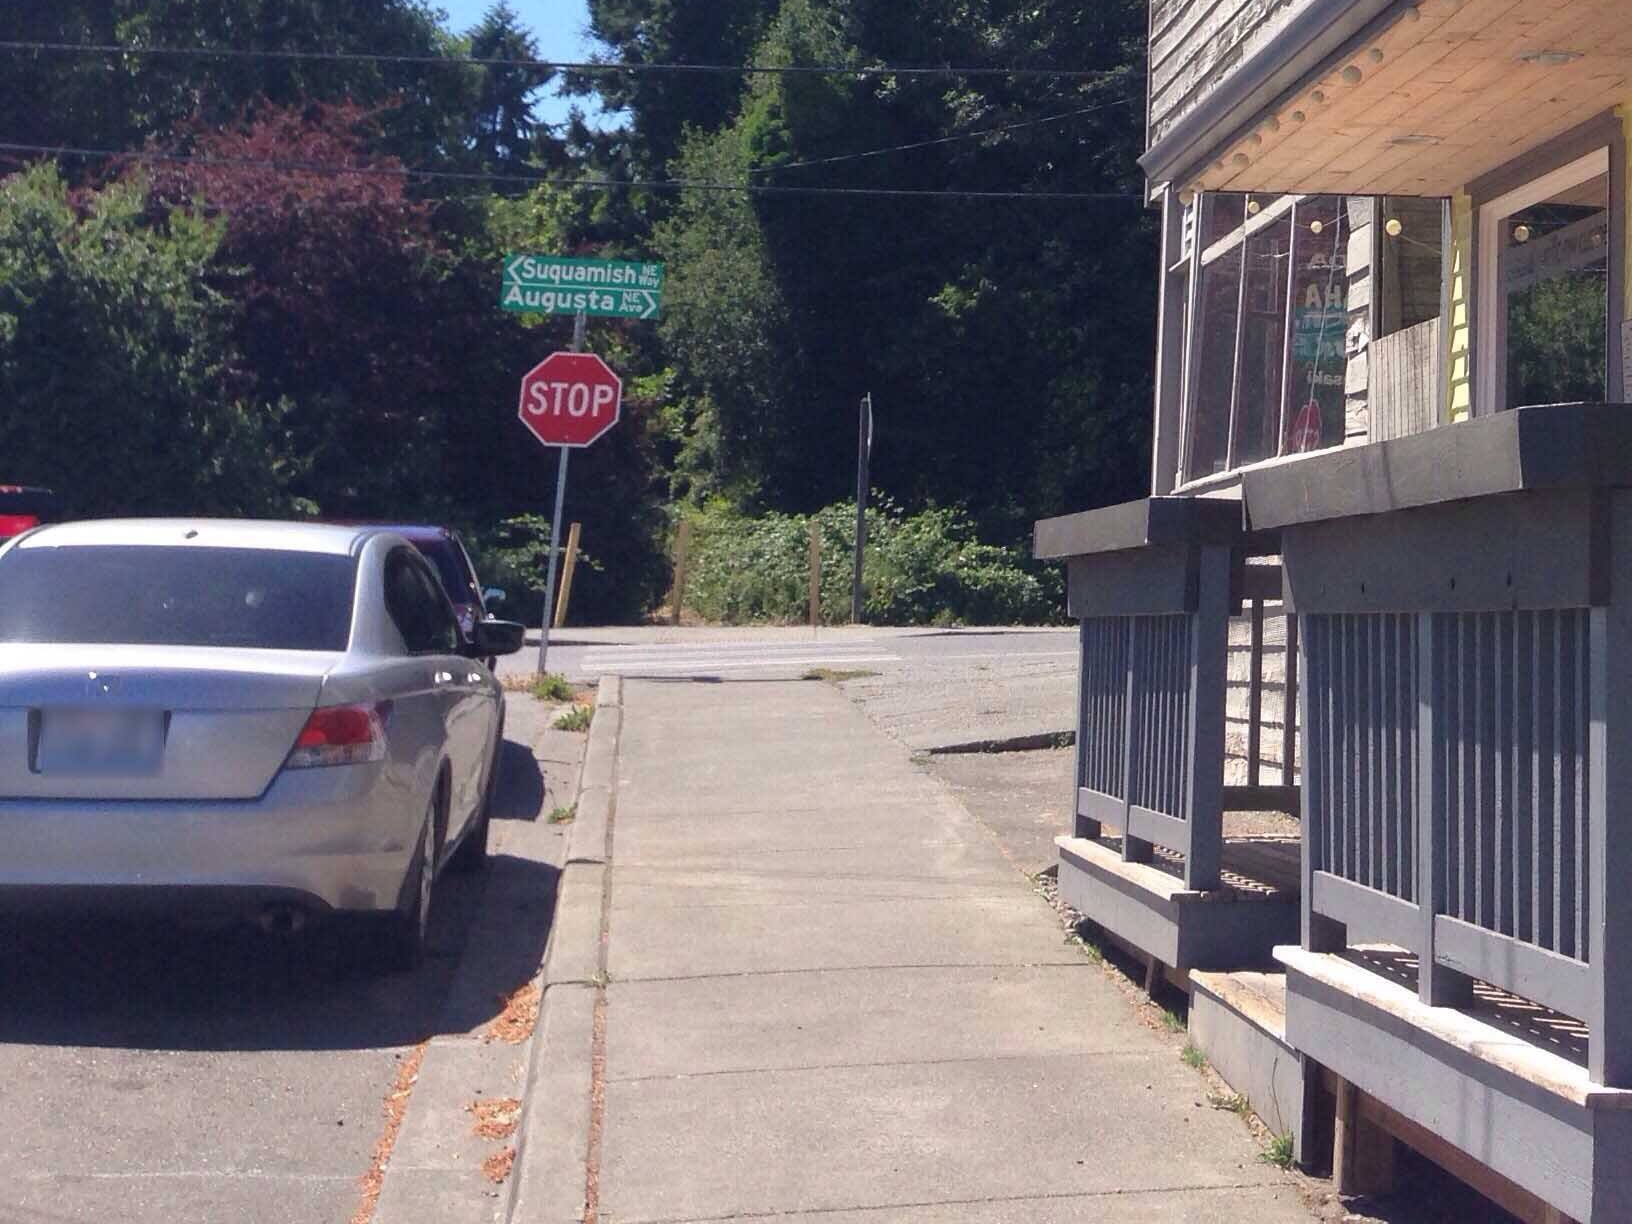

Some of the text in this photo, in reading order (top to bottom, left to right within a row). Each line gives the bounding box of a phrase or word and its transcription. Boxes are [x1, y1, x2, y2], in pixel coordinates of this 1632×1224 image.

[521, 258, 637, 284] Suquamish
[642, 264, 657, 276] NE
[638, 275, 660, 288] Way
[504, 285, 615, 313] Augusta
[621, 291, 641, 303] NE
[618, 303, 643, 313] Ave
[527, 381, 614, 417] STOP
